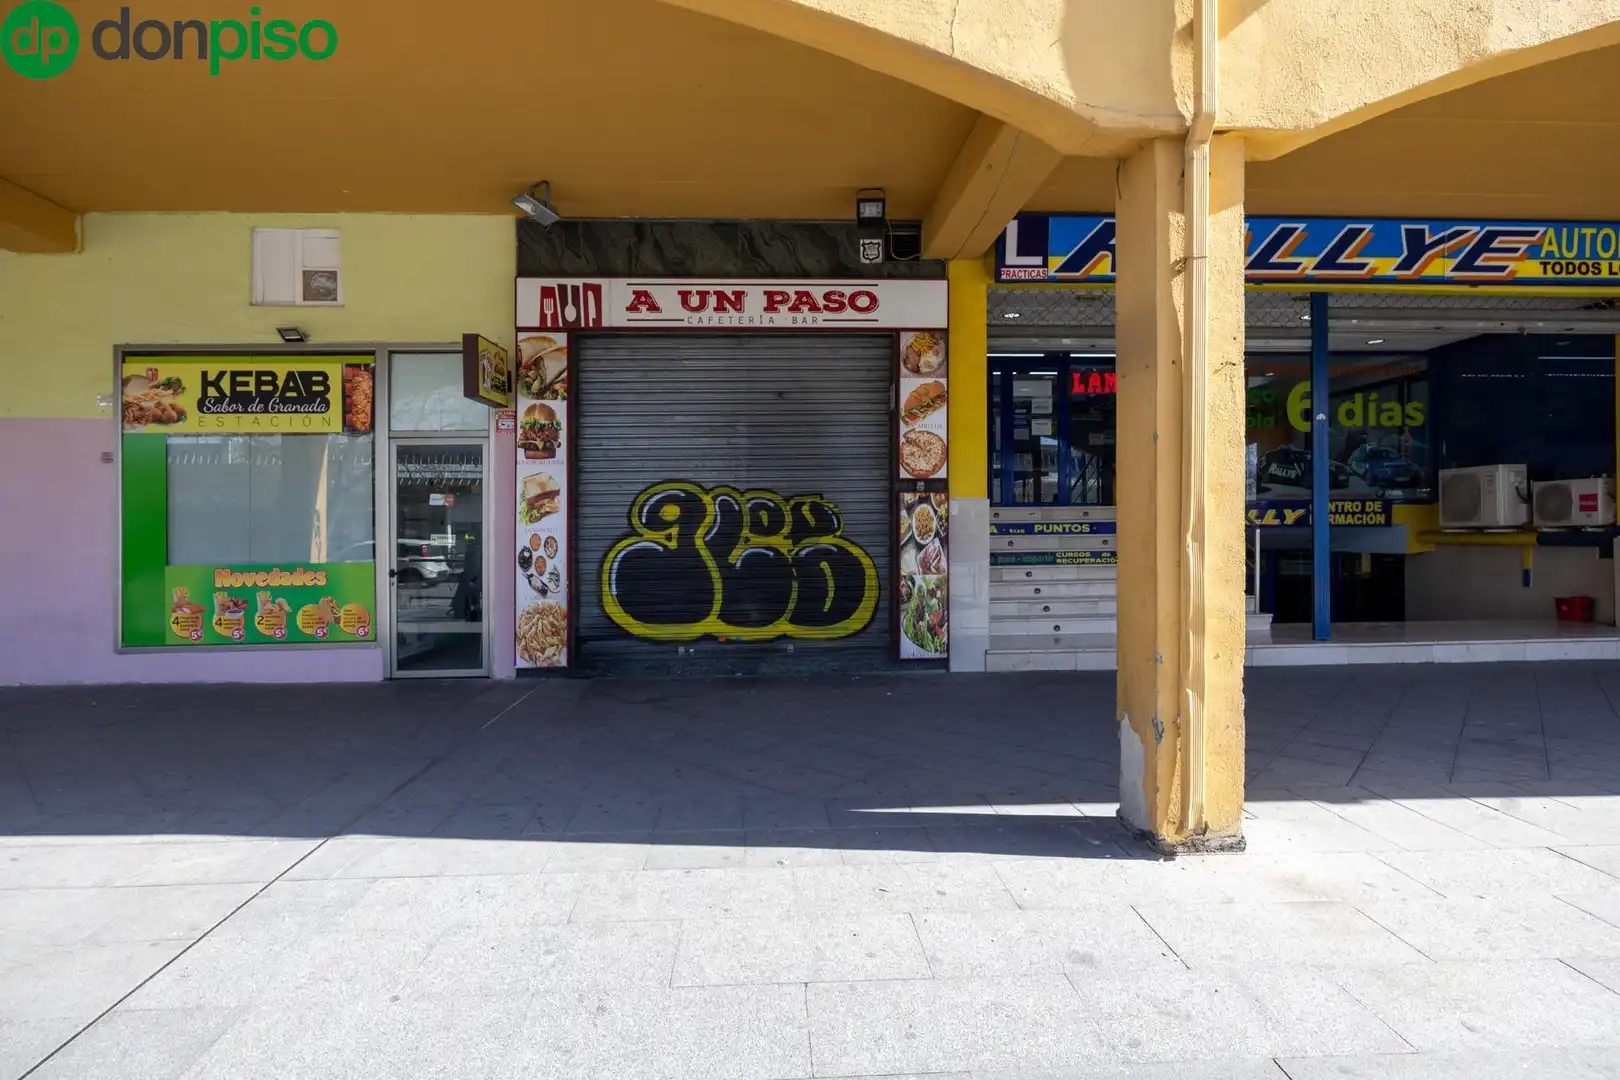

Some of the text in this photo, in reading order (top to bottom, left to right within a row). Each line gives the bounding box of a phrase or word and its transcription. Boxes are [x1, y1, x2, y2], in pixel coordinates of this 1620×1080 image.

[1005, 219, 1043, 265] L
[1540, 227, 1620, 258] AUTO
[1001, 268, 1047, 279] PRACTICAS
[1539, 261, 1620, 275] TODOS L
[625, 290, 879, 313] A UN PASO
[687, 314, 819, 324] CAFETERÍA BAR
[201, 370, 331, 397] KEBAB
[203, 397, 328, 413] Sabor de Granada
[1337, 392, 1425, 427] días
[198, 415, 331, 427] ESTACIÓN
[1329, 501, 1383, 512] NTRO DE
[1329, 513, 1386, 525] RMACIÓN
[1034, 524, 1091, 533] PUNTOS
[213, 568, 328, 588] Novedades
[172, 616, 180, 626] 4
[215, 617, 223, 627] 4
[257, 615, 265, 625] 2
